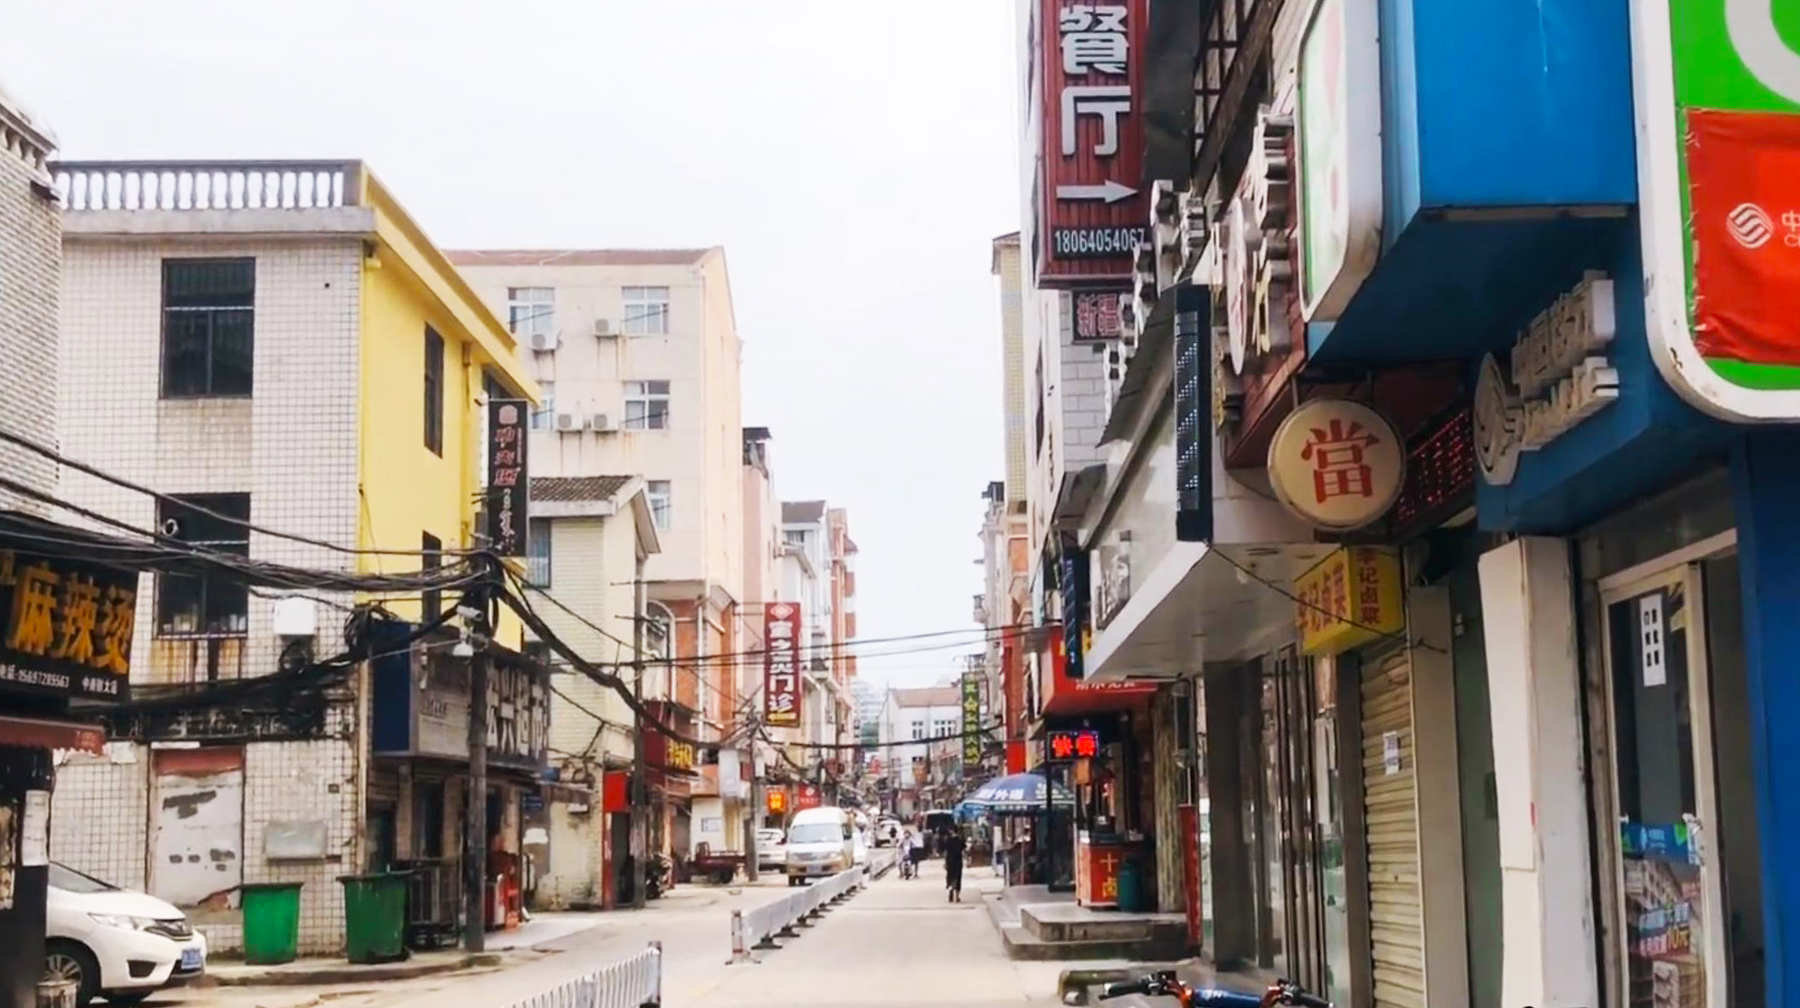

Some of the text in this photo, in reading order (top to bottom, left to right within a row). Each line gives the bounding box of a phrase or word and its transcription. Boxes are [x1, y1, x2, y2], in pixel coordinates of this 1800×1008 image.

[1059, 6, 1132, 157] 餐厅
[1054, 227, 1146, 254] 18064054067
[1300, 418, 1381, 504] 當
[6, 561, 135, 675] 麻辣烫
[1052, 734, 1095, 758] 快餐
